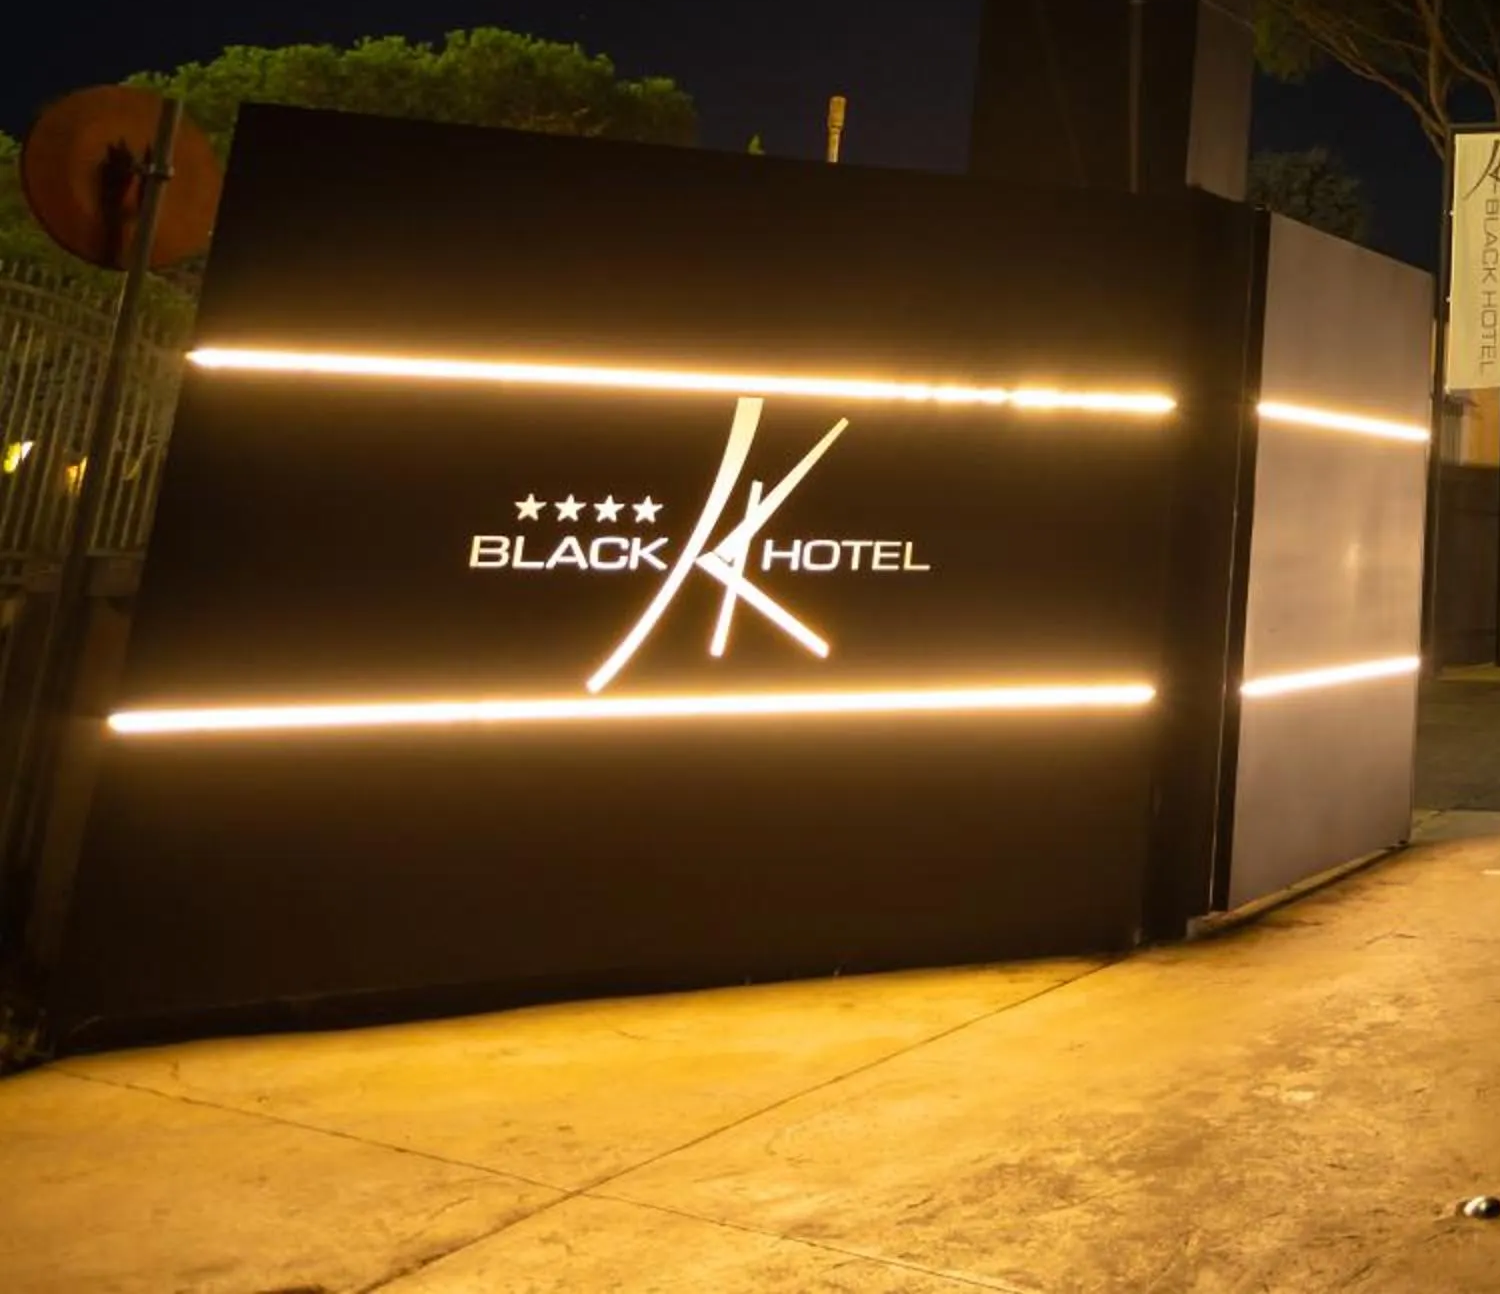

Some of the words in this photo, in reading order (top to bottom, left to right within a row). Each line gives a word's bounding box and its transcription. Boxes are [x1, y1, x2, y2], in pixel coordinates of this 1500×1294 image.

[1481, 199, 1500, 284] BLACK
[1479, 290, 1498, 376] HOTEL
[469, 535, 669, 572] BLACK
[761, 538, 931, 572] HOTEL
